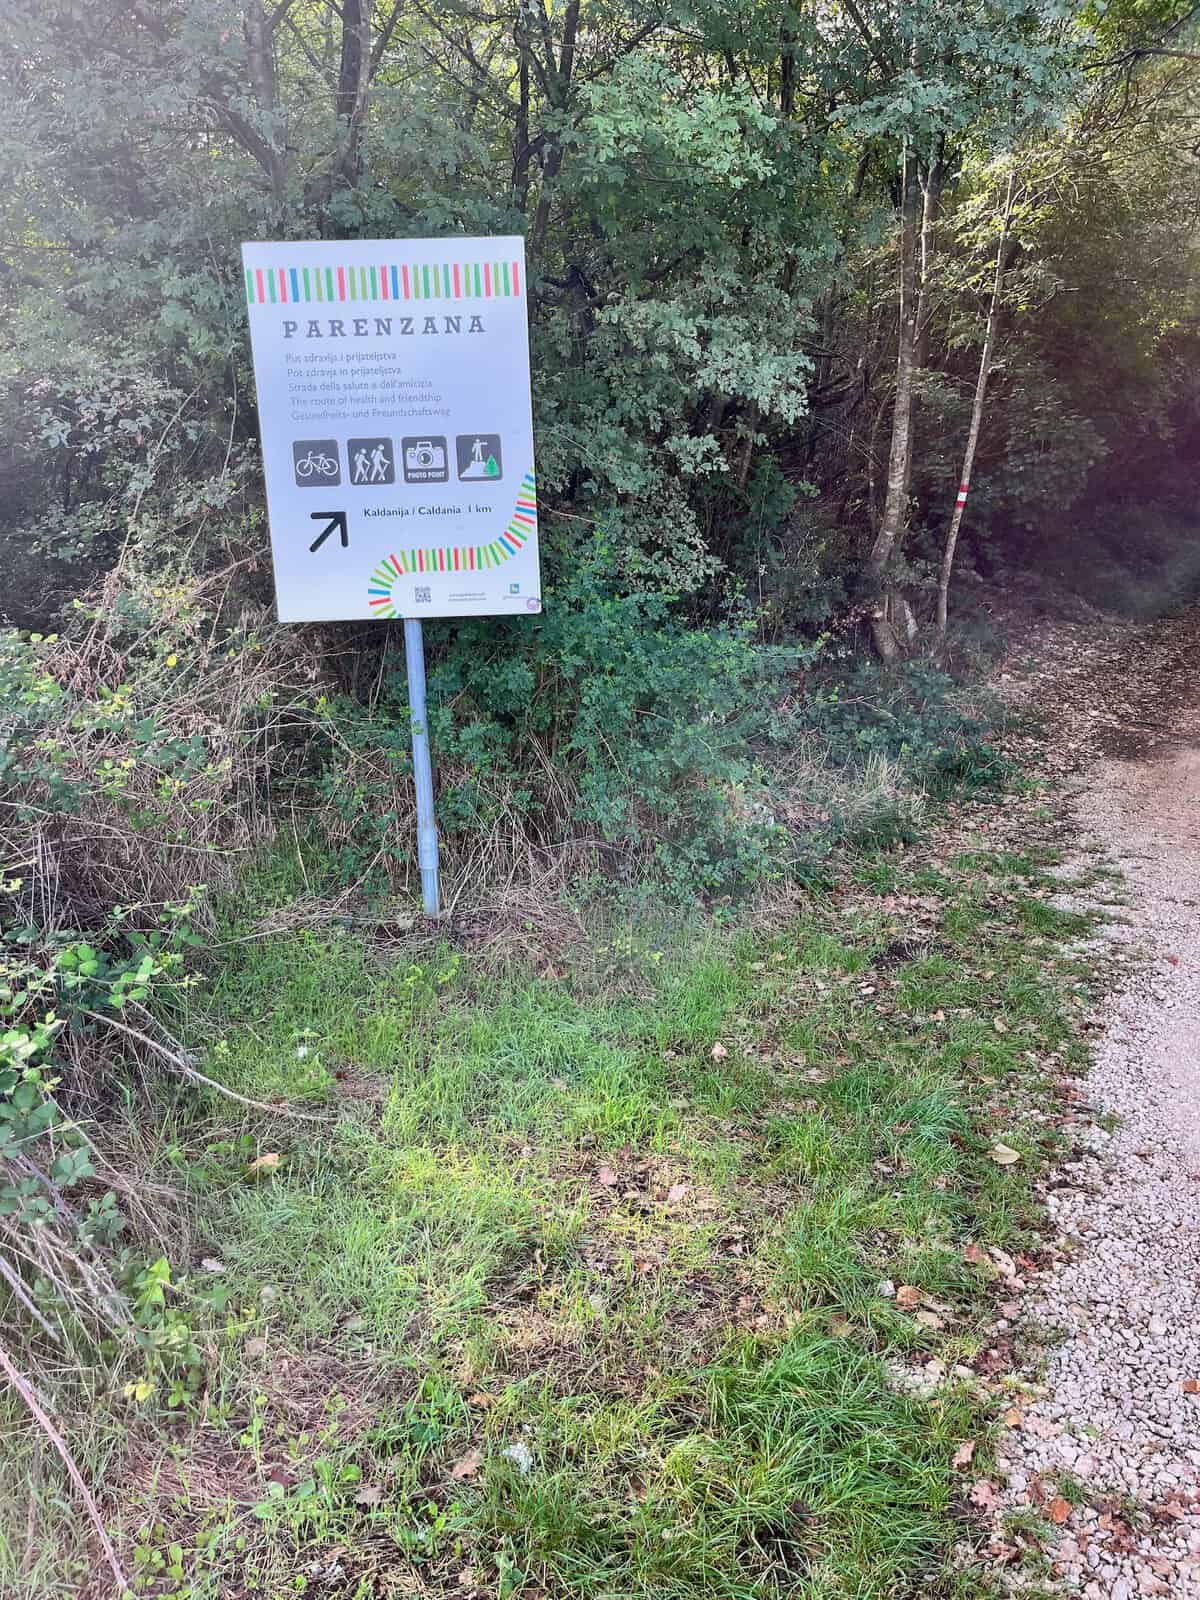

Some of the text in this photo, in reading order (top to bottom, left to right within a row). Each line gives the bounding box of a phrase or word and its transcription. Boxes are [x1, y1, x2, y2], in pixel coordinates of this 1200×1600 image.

[282, 315, 486, 339] PARENZANA
[346, 351, 397, 363] prijateljstva
[287, 365, 401, 379] Pot zdravja in prijateljstva
[288, 382, 317, 392] Strada
[320, 382, 340, 392] della
[343, 381, 369, 391] salute
[290, 391, 442, 406] The route of health and friendship
[352, 408, 370, 418] und
[372, 406, 451, 419] Freundschaftsweg
[364, 506, 409, 518] Kaldanija
[418, 505, 461, 516] Caldania
[475, 503, 492, 513] km
